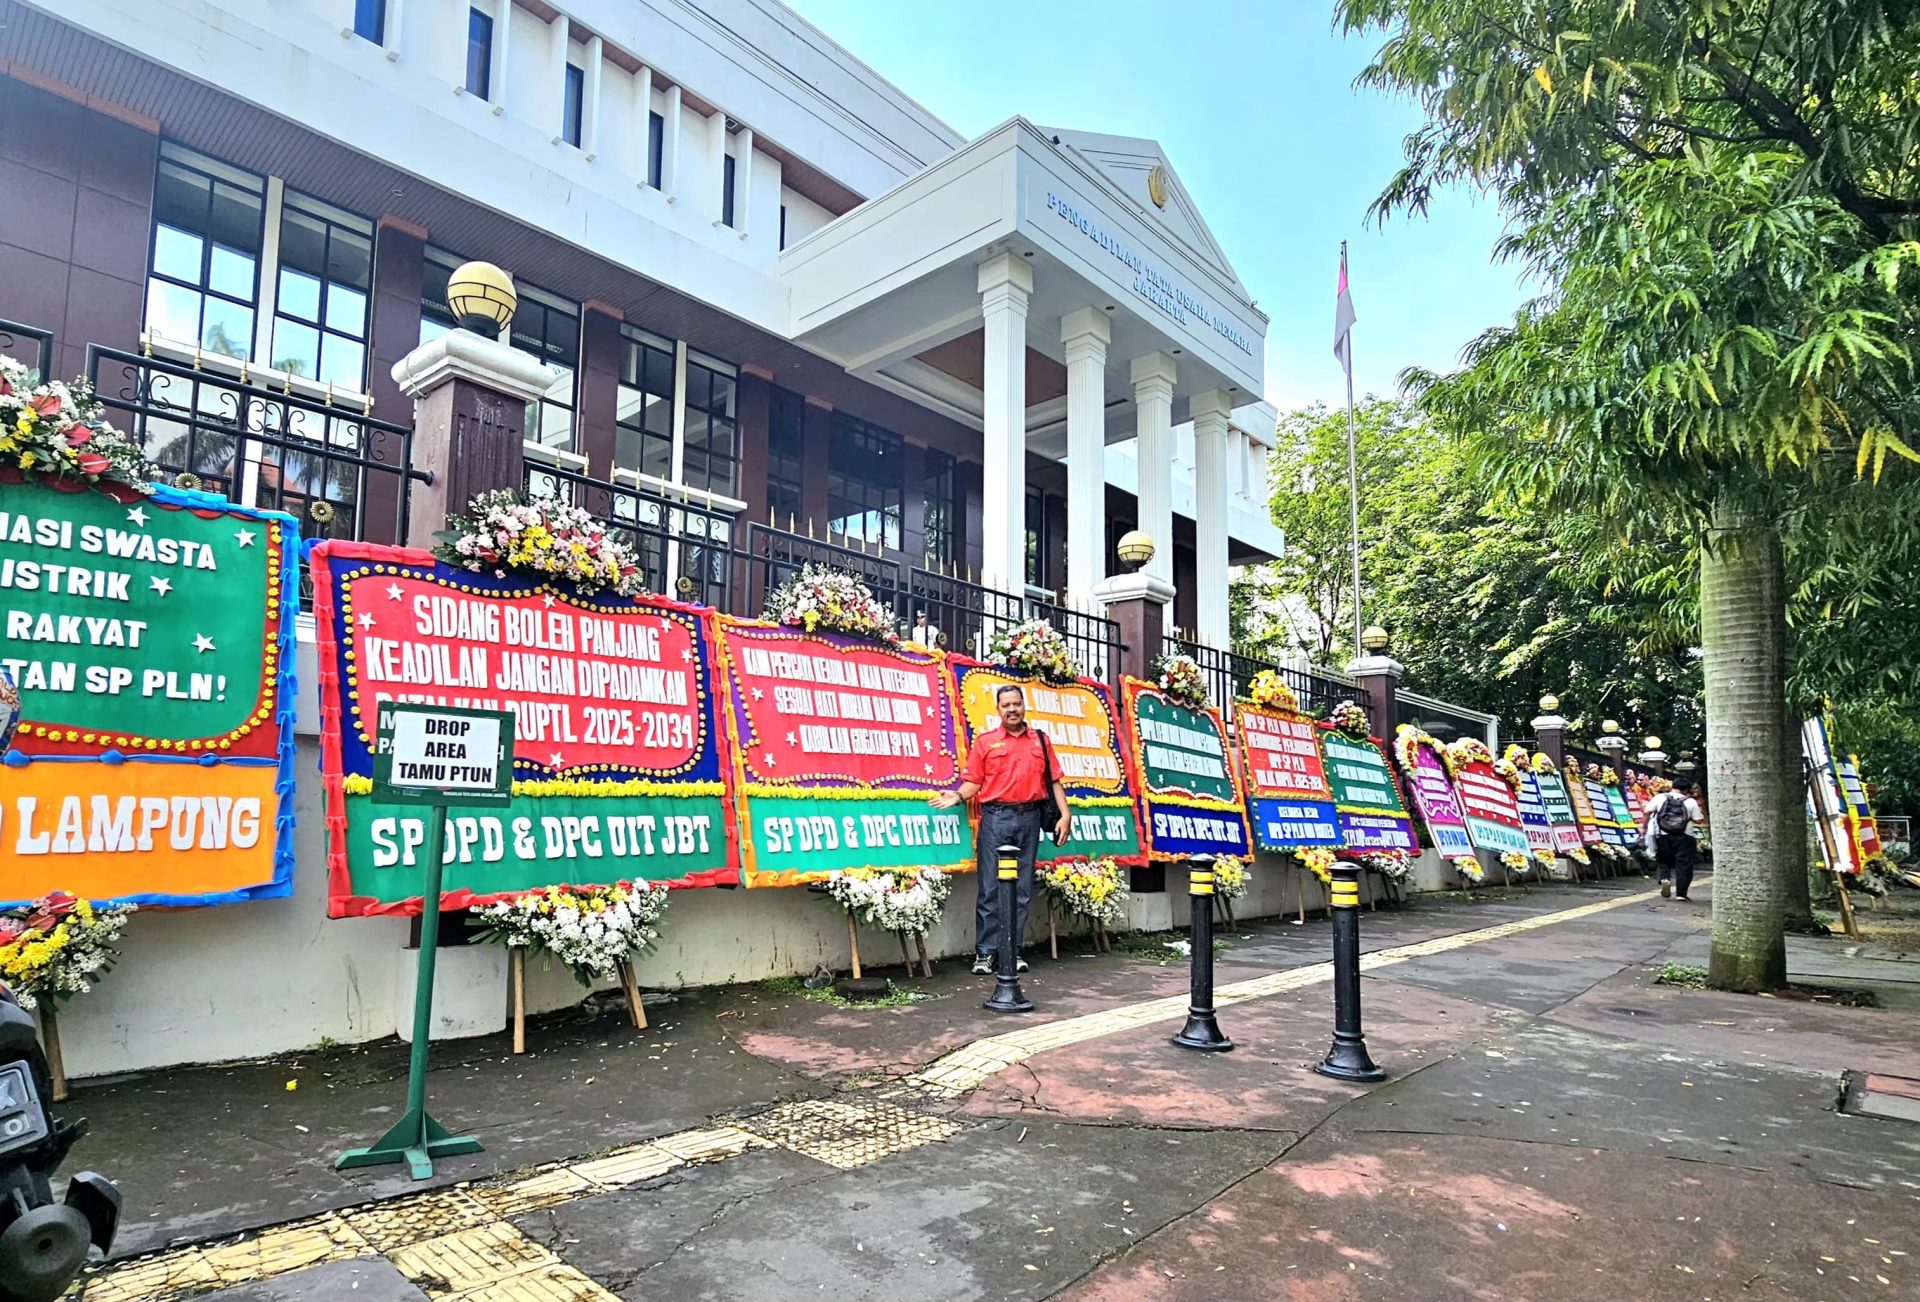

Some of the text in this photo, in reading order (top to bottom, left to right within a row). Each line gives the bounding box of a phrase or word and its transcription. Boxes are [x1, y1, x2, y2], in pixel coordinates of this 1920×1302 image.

[80, 524, 216, 570] SWASTA
[7, 610, 146, 648] RAKYAT
[413, 595, 661, 662] SIDANG BOLEH PANJANG
[85, 666, 132, 694] SP
[142, 670, 226, 702] PLN!
[364, 637, 688, 706] KEADILAN JANGAN DIPADAMKAN
[425, 719, 470, 736] DROP
[583, 709, 694, 749] 2025-2034
[424, 742, 467, 759] AREA
[399, 763, 492, 783] TAMU PTUN
[16, 795, 260, 855] LAMPUNG
[371, 817, 424, 867] SP
[512, 816, 536, 860] &
[541, 816, 603, 859] DPC
[608, 816, 656, 857] UIT
[661, 815, 711, 854] JBT
[764, 814, 961, 853] SP DPD & DPC UIT JBT
